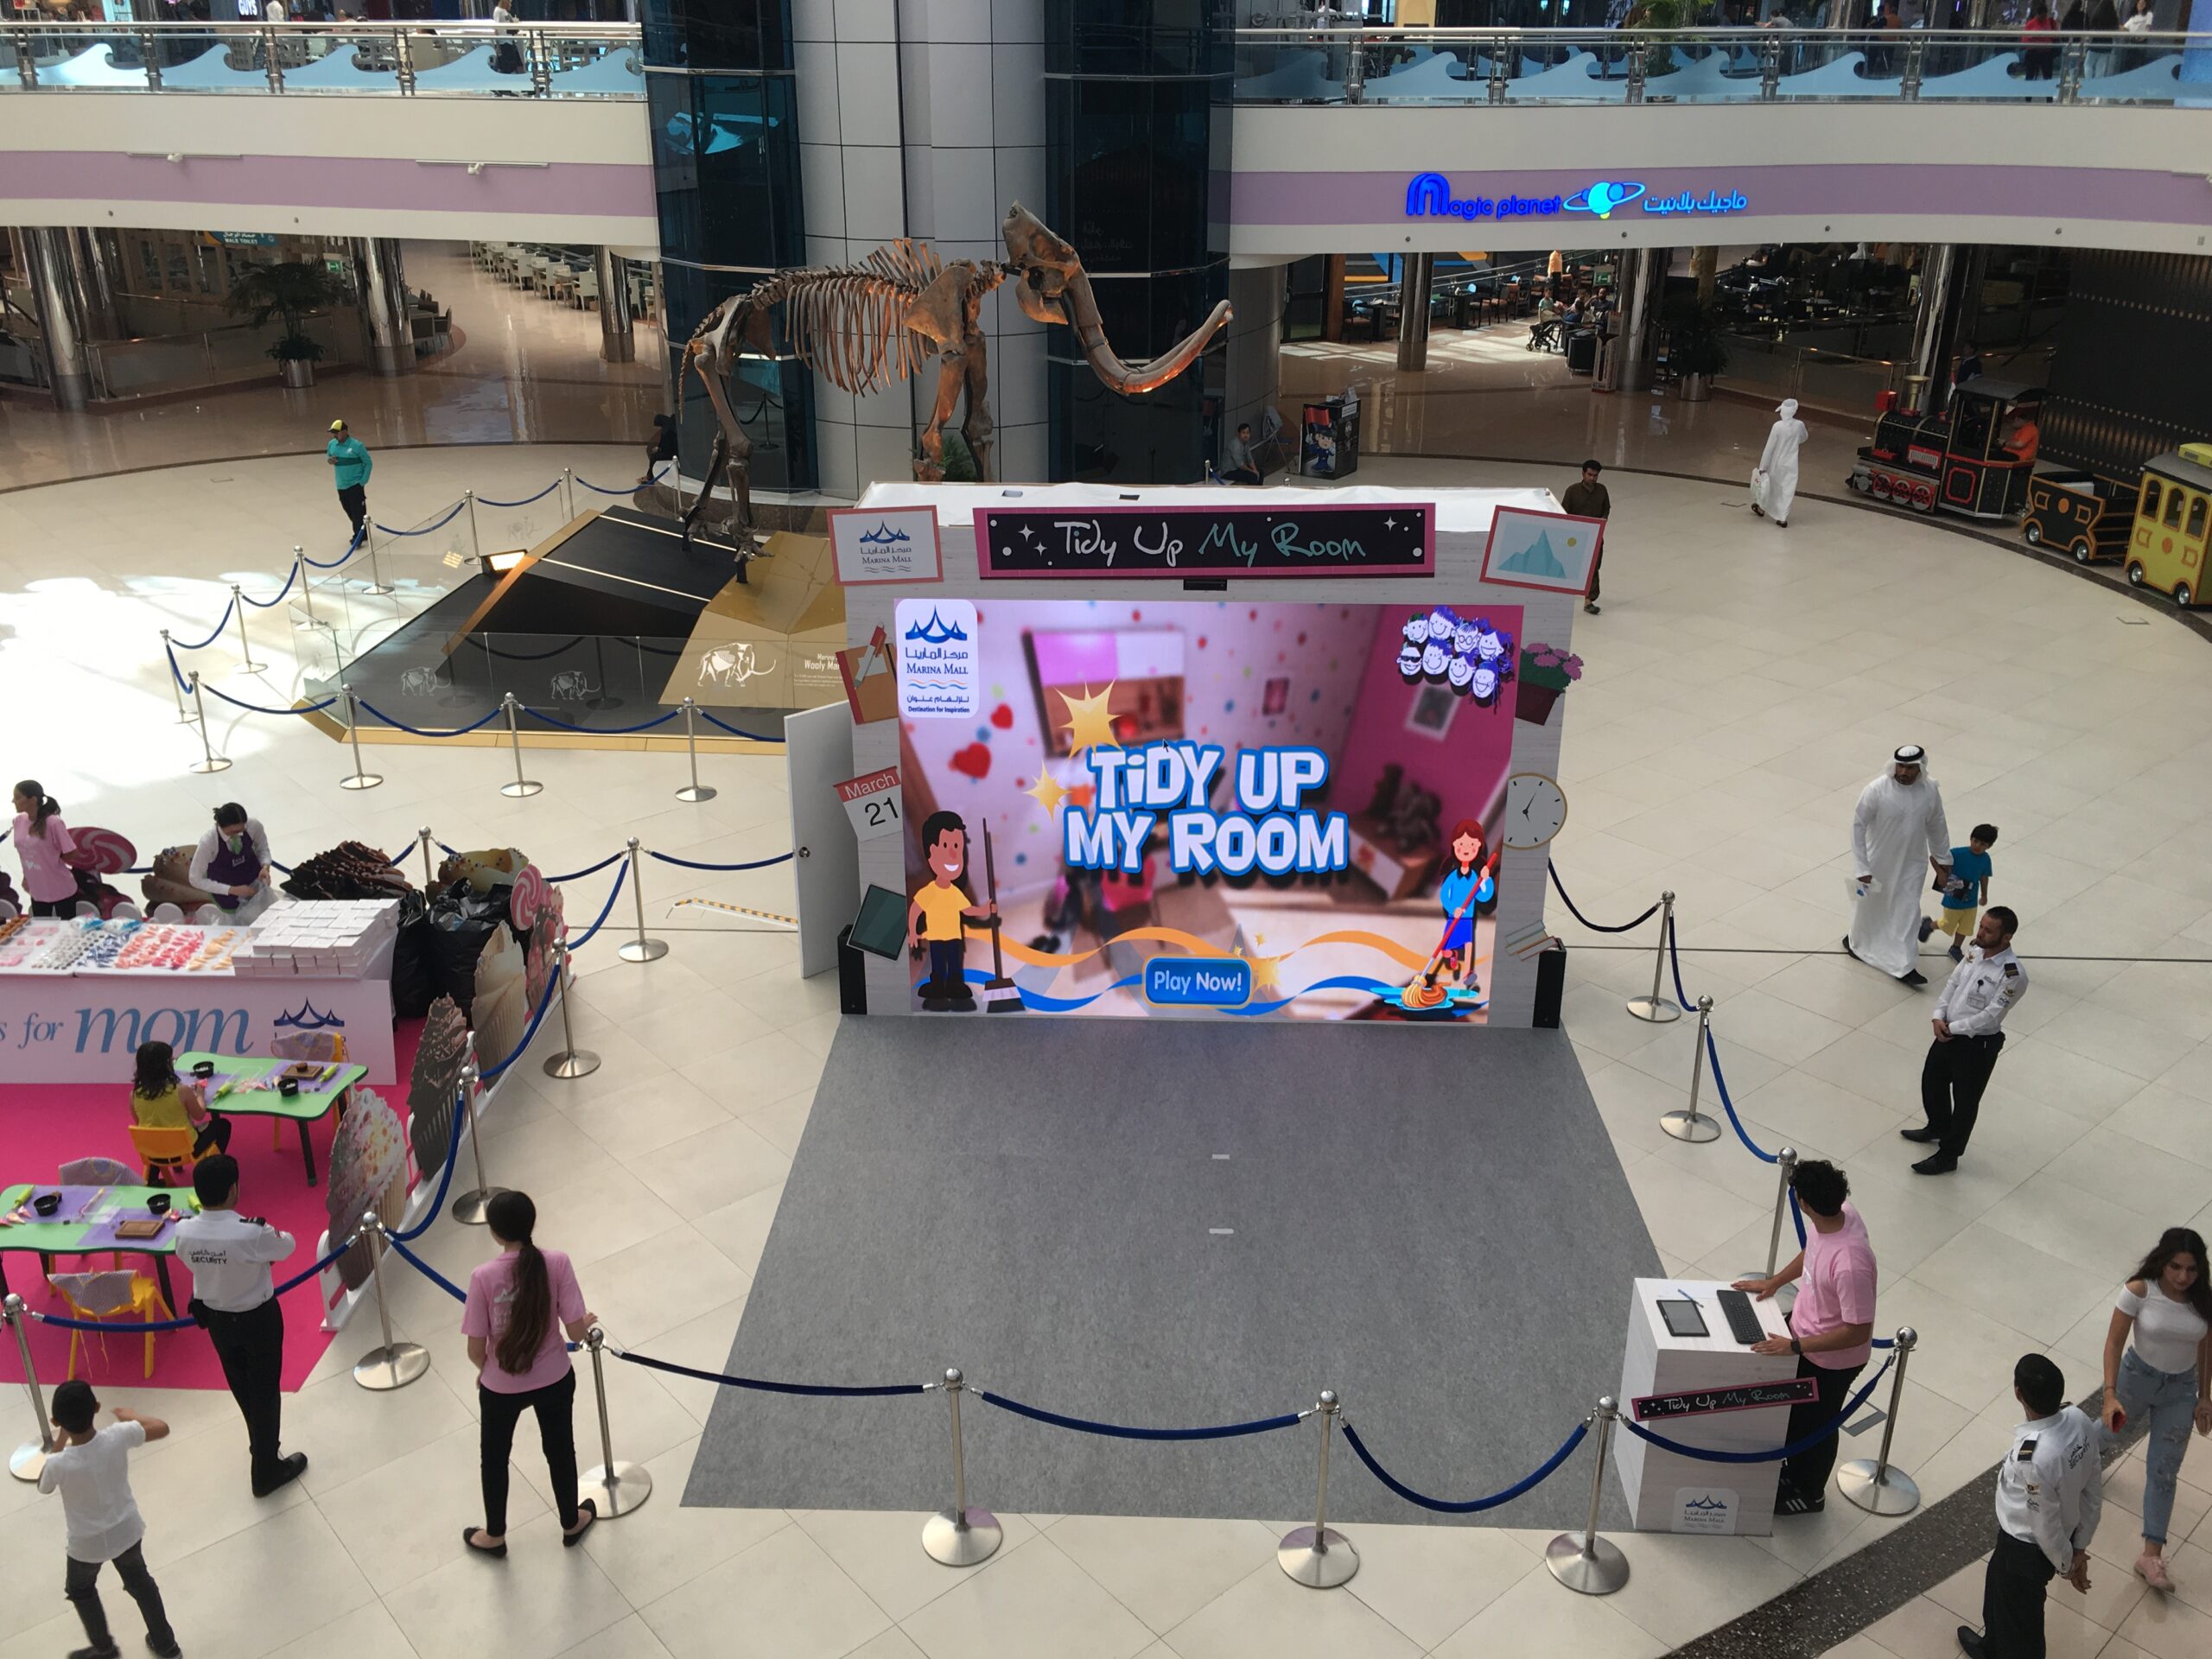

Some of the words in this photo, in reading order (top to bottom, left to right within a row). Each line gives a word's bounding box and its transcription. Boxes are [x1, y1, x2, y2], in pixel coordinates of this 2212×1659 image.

[238, 0, 257, 16] GUYS
[1406, 173, 1493, 220] Magic
[1496, 194, 1560, 220] planet
[1644, 191, 1695, 214] بلانيت
[1697, 190, 1747, 213] ماجيك
[1053, 519, 1117, 567] Tidy
[1134, 521, 1184, 567] Up
[1198, 521, 1258, 568] My
[1270, 522, 1365, 561] Room
[892, 555, 912, 563] MALL
[804, 659, 826, 671] Wooly
[943, 649, 969, 660] مركز
[906, 663, 942, 674] MARINA
[944, 663, 969, 675] MALL
[844, 773, 896, 799] March
[1237, 748, 1327, 811] UP
[864, 797, 899, 827] 21
[1066, 808, 1154, 870] MY
[1170, 810, 1346, 874] ROOM
[1154, 969, 1192, 995] Play
[1196, 971, 1242, 992] Now!
[17, 1012, 64, 1050] for
[74, 1007, 254, 1055] mom
[191, 1256, 227, 1265] SECURITY
[1663, 1396, 1690, 1413] Tidy
[1695, 1394, 1717, 1410] Up
[1723, 1392, 1746, 1407] My
[1751, 1389, 1789, 1402] Room
